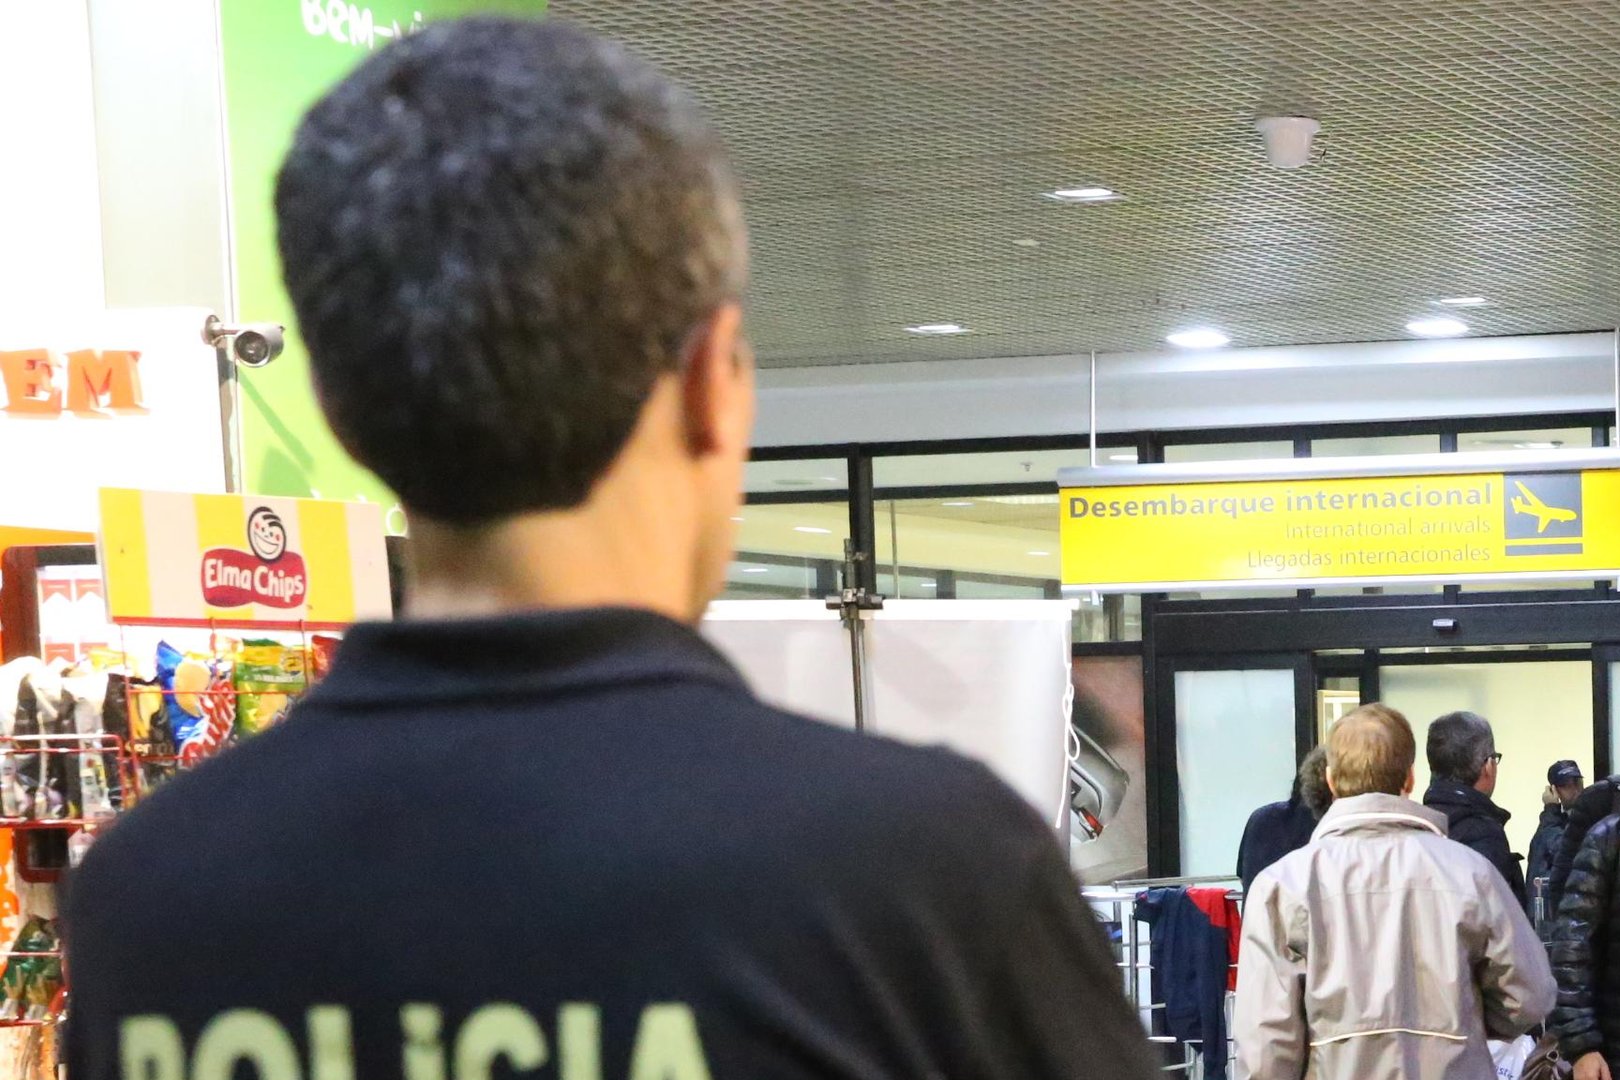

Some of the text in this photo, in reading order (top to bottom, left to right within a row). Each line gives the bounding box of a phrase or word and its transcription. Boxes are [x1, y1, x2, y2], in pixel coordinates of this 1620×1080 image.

[1070, 483, 1492, 519] Desembarque internacional
[1286, 515, 1491, 539] International arrivals
[1247, 544, 1491, 572] Llegadas internacionales
[205, 558, 305, 603] Elma Chips
